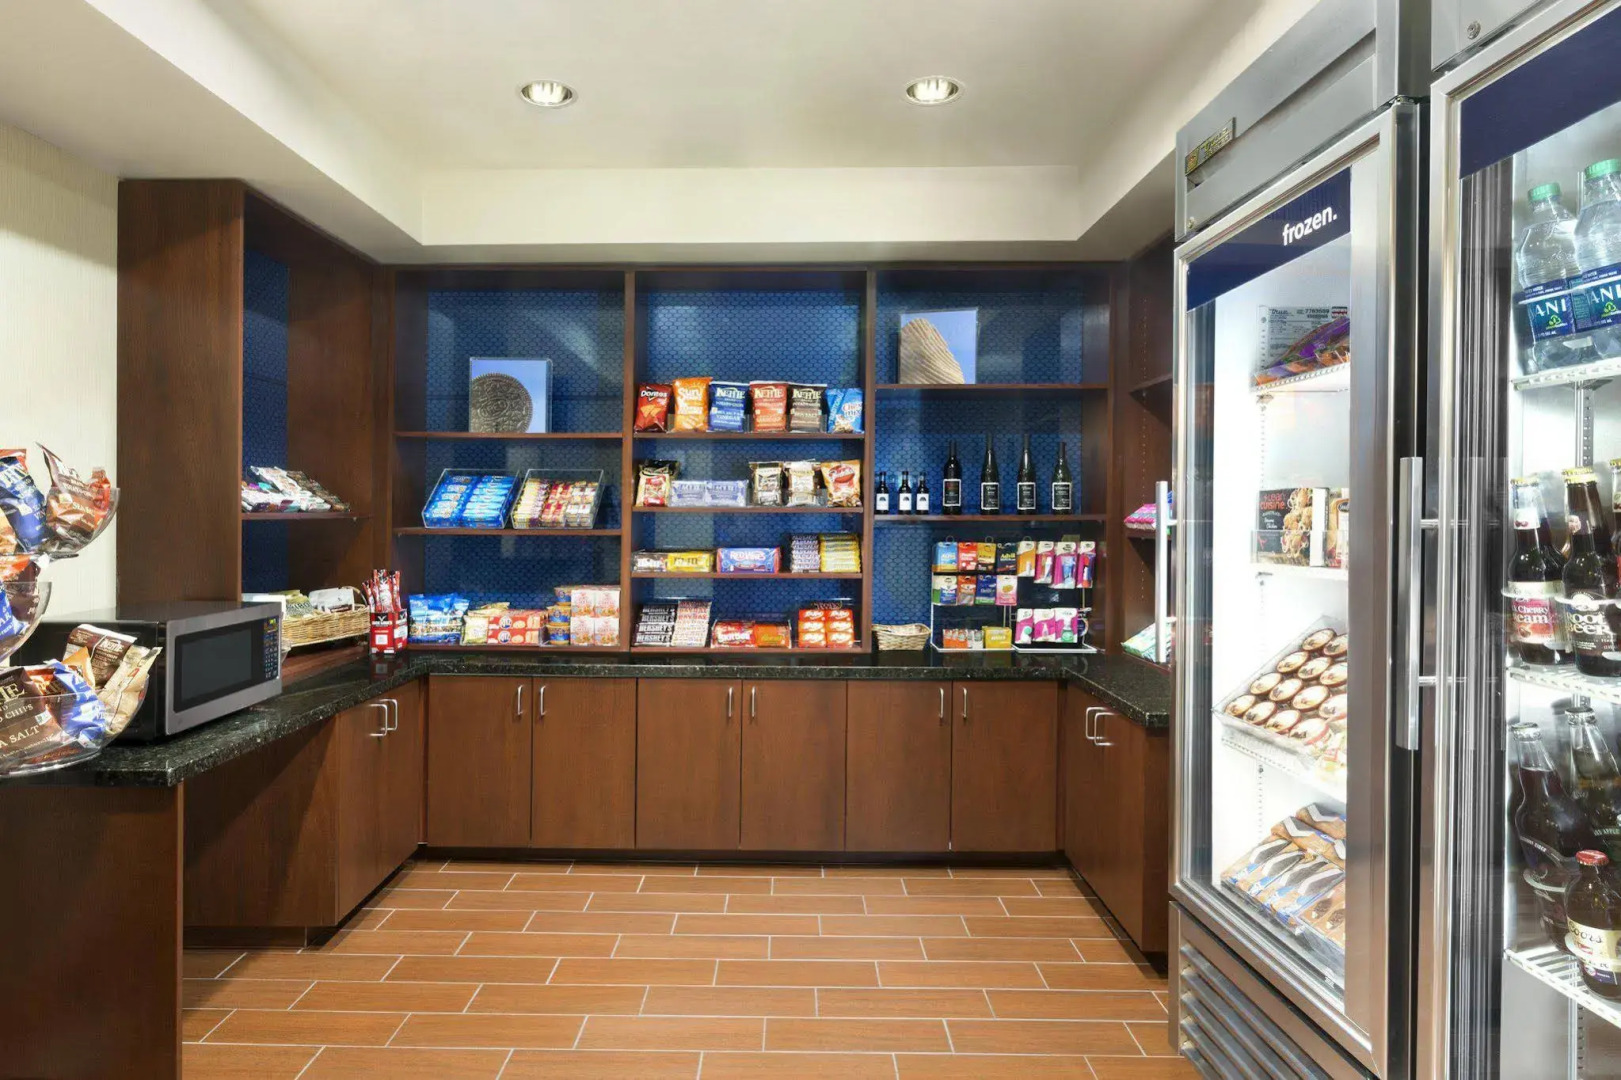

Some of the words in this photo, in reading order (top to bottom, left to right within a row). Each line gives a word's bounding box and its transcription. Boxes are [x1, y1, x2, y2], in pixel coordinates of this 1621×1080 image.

[1282, 206, 1338, 246] frozen.
[640, 389, 668, 399] Doritos
[638, 624, 673, 632] HERSHEY'S
[5, 704, 33, 719] CHIPS
[9, 725, 39, 743] SALT
